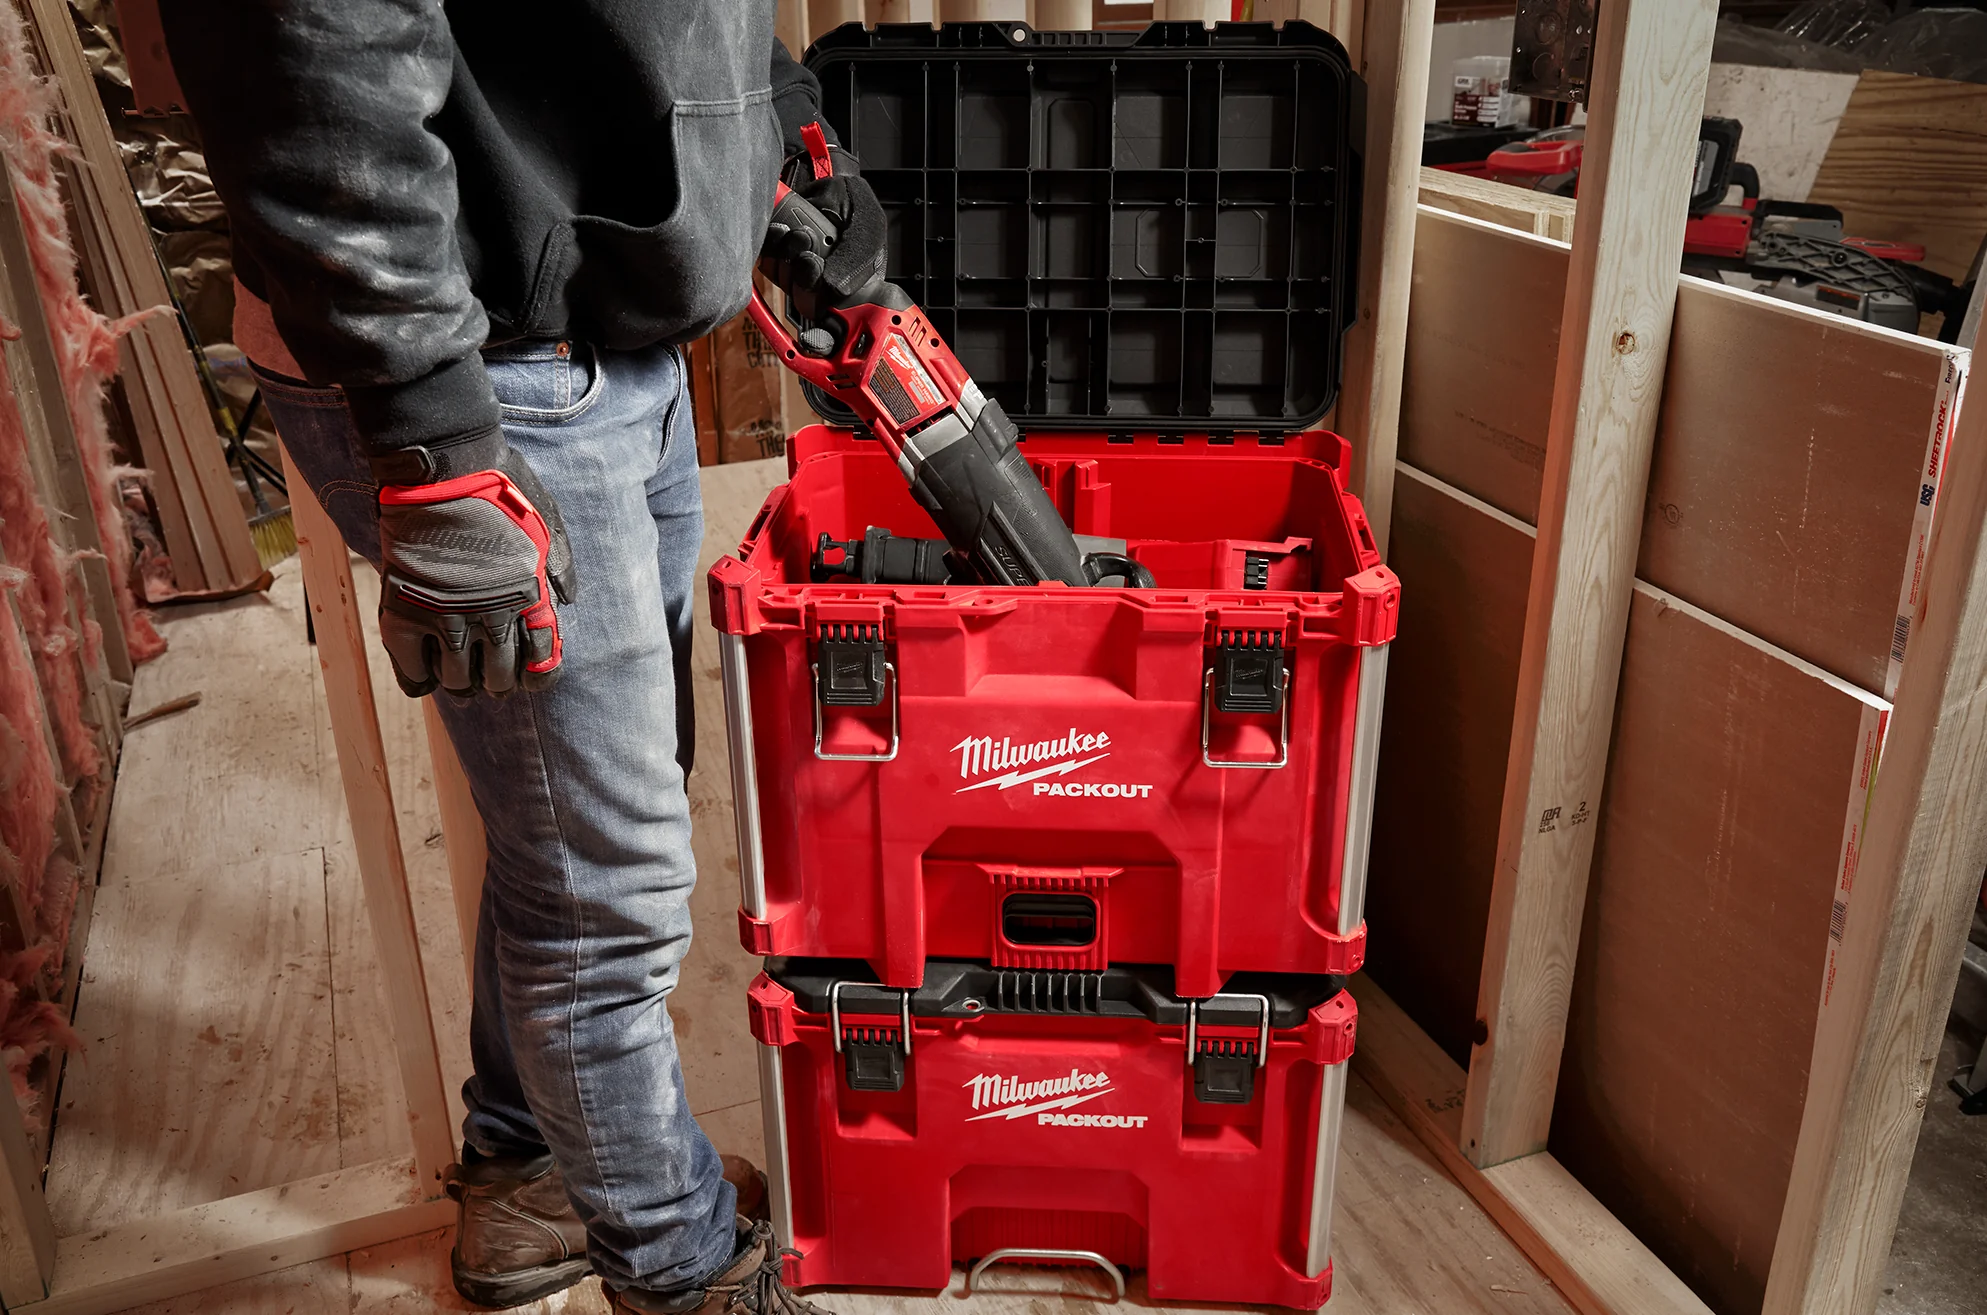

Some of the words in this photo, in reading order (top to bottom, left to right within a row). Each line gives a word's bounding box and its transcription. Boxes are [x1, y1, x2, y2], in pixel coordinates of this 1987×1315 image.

[1919, 483, 1936, 506] USG
[950, 728, 1111, 779] Milwaukee
[1033, 782, 1153, 798] PACKOUT
[1578, 801, 1587, 812] 2
[962, 1068, 1111, 1110] Milwaukee
[1038, 1113, 1148, 1128] PACKOUT
